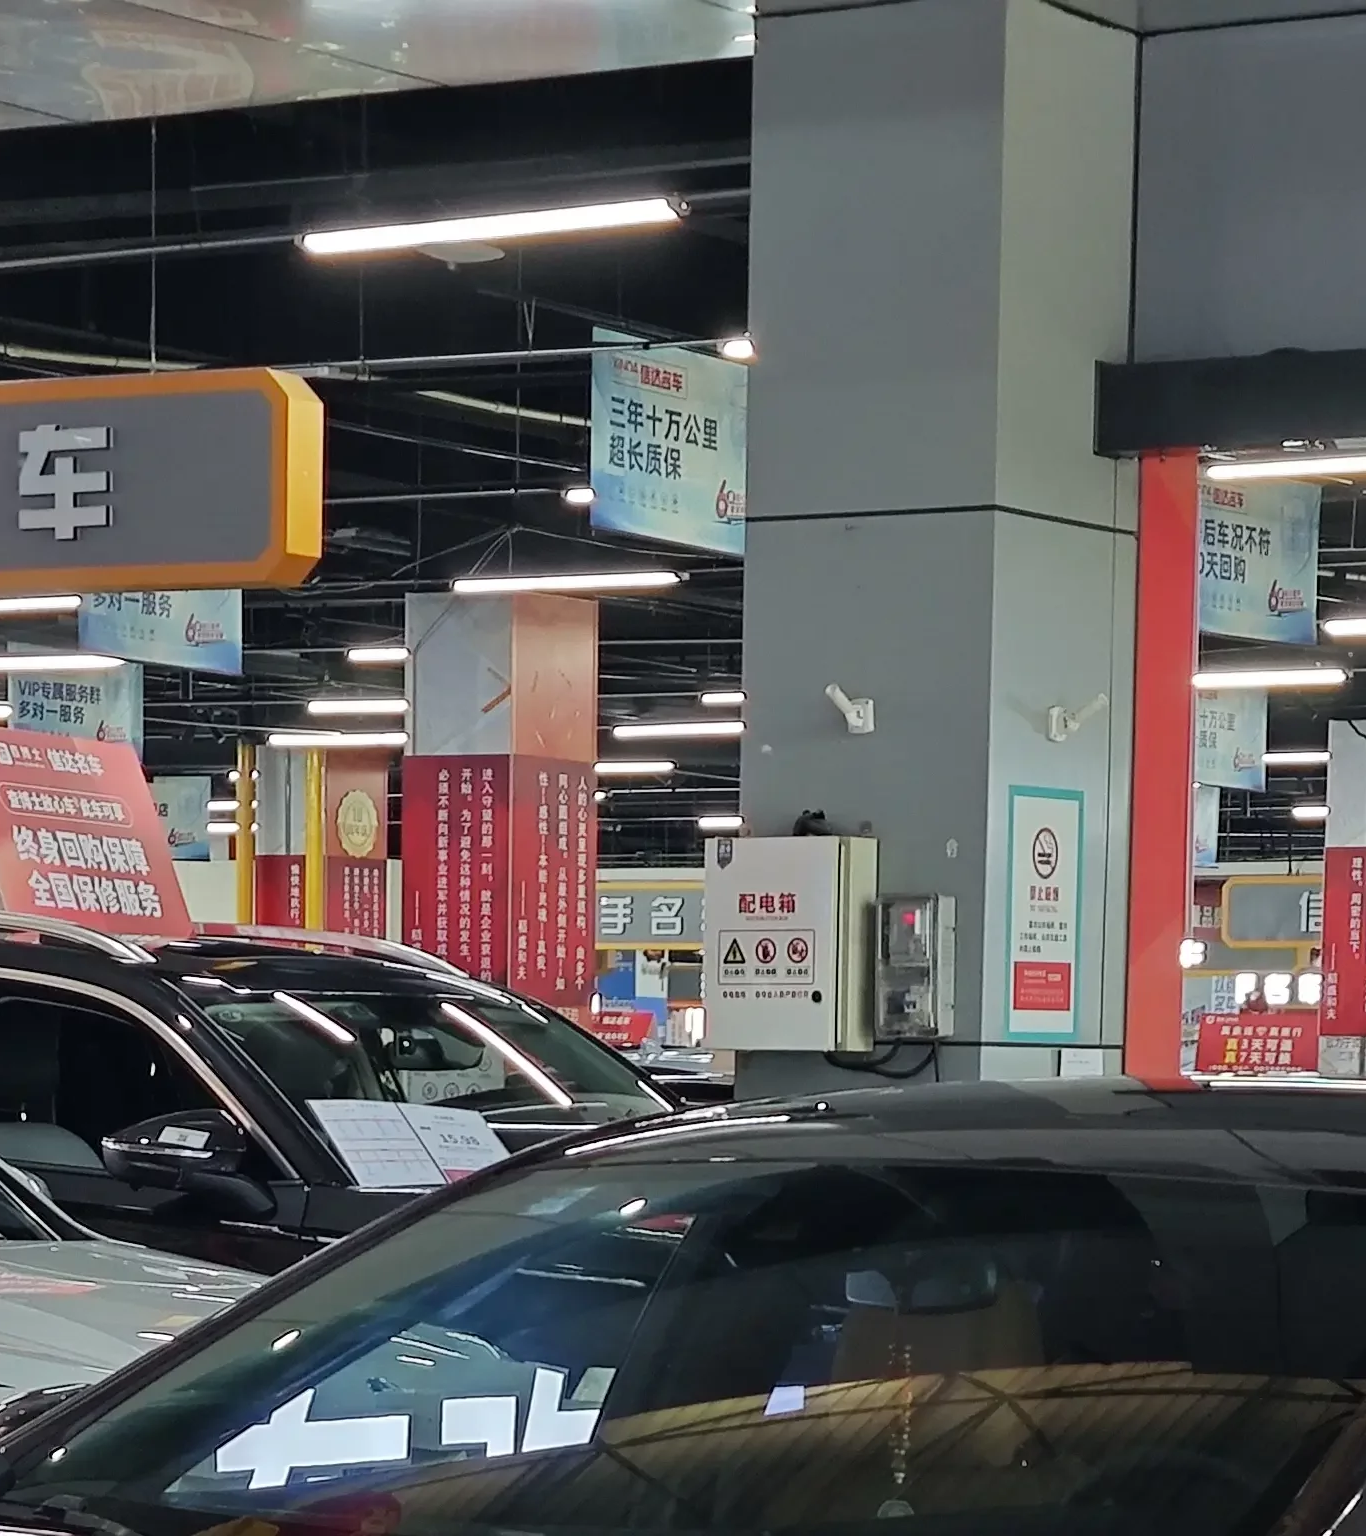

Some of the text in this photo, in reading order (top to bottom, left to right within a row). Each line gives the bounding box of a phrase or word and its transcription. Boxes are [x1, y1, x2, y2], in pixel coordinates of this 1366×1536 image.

[609, 396, 718, 451] 三年十万公里
[608, 432, 682, 480] 超长质保
[1203, 518, 1271, 557] 后车况不符
[17, 679, 102, 706] VIP专属服务群
[17, 700, 86, 725] 多对一服务
[47, 748, 104, 776] 信达名车
[12, 825, 151, 876] 终身回购保障
[27, 869, 163, 918] 全国保修服务
[738, 892, 797, 914] 配电箱
[599, 896, 704, 935] 手名
